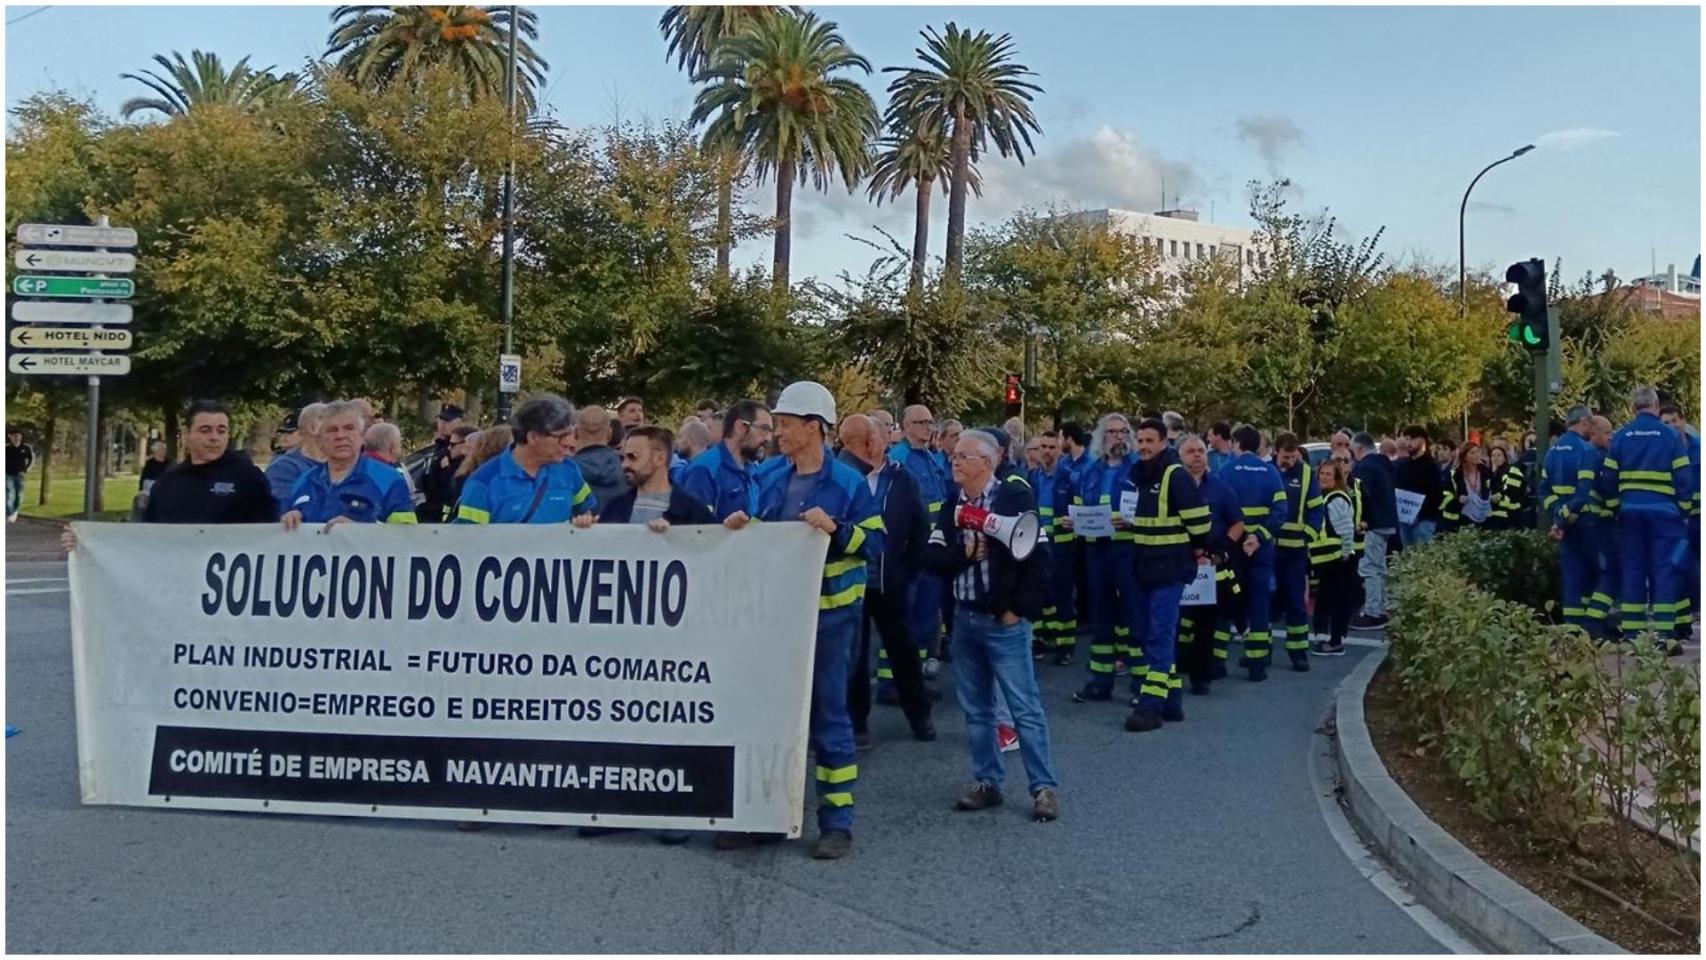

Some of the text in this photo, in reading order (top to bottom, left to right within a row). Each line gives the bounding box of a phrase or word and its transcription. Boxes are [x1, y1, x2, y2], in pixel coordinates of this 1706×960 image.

[35, 280, 47, 292] P
[44, 331, 127, 341] HOTEL NIDO
[43, 357, 121, 367] HOTEL MAYCAR
[202, 552, 688, 627] SOLUCION DO CONVENIO
[173, 643, 235, 667] PLAN
[243, 646, 392, 672] INDUSTRIAL
[542, 654, 577, 677] DA
[585, 655, 711, 684] COMARCA
[447, 697, 463, 719] E
[472, 697, 602, 722] DEREITOS
[609, 699, 715, 724] SOCIAIS
[170, 748, 694, 793] COMITÉ DE EMPRESA NAVANTIA-FERROL
